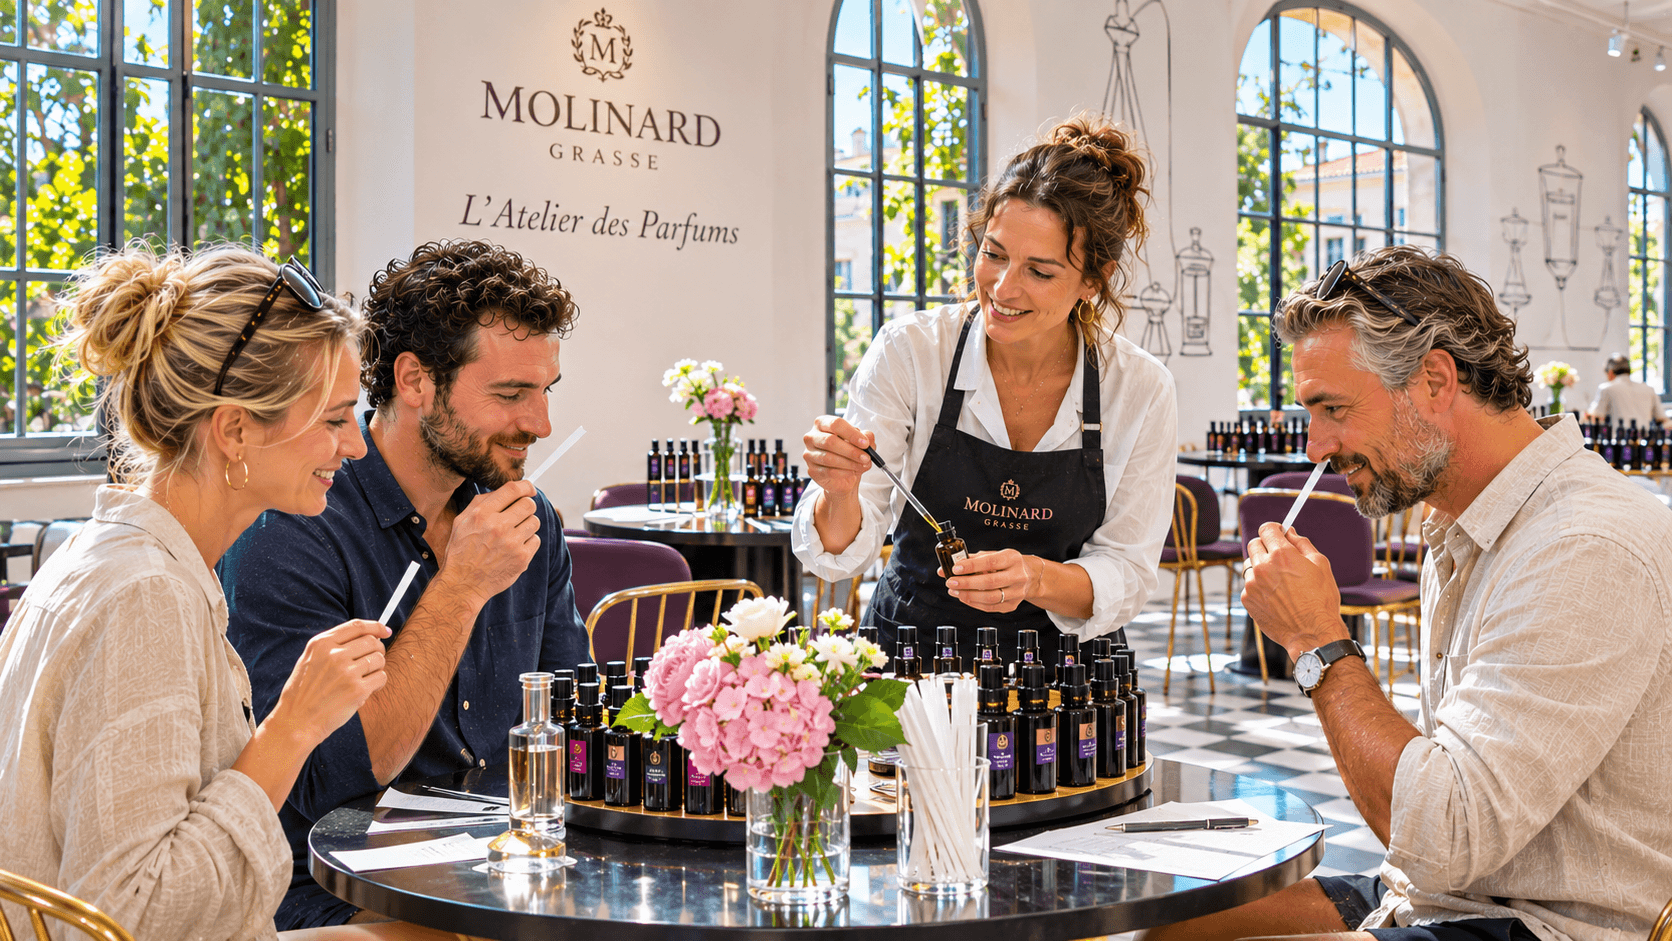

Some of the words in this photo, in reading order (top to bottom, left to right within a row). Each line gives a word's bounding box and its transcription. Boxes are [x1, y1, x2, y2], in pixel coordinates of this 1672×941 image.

[589, 33, 617, 64] M
[480, 80, 721, 148] MOLINARD
[549, 142, 659, 170] GRASSE
[458, 193, 584, 233] L’Atelier
[591, 205, 630, 237] des
[638, 209, 740, 251] Parfums
[1004, 485, 1015, 496] M
[963, 496, 1053, 520] MOLINARD
[983, 518, 1029, 531] GRASSE
